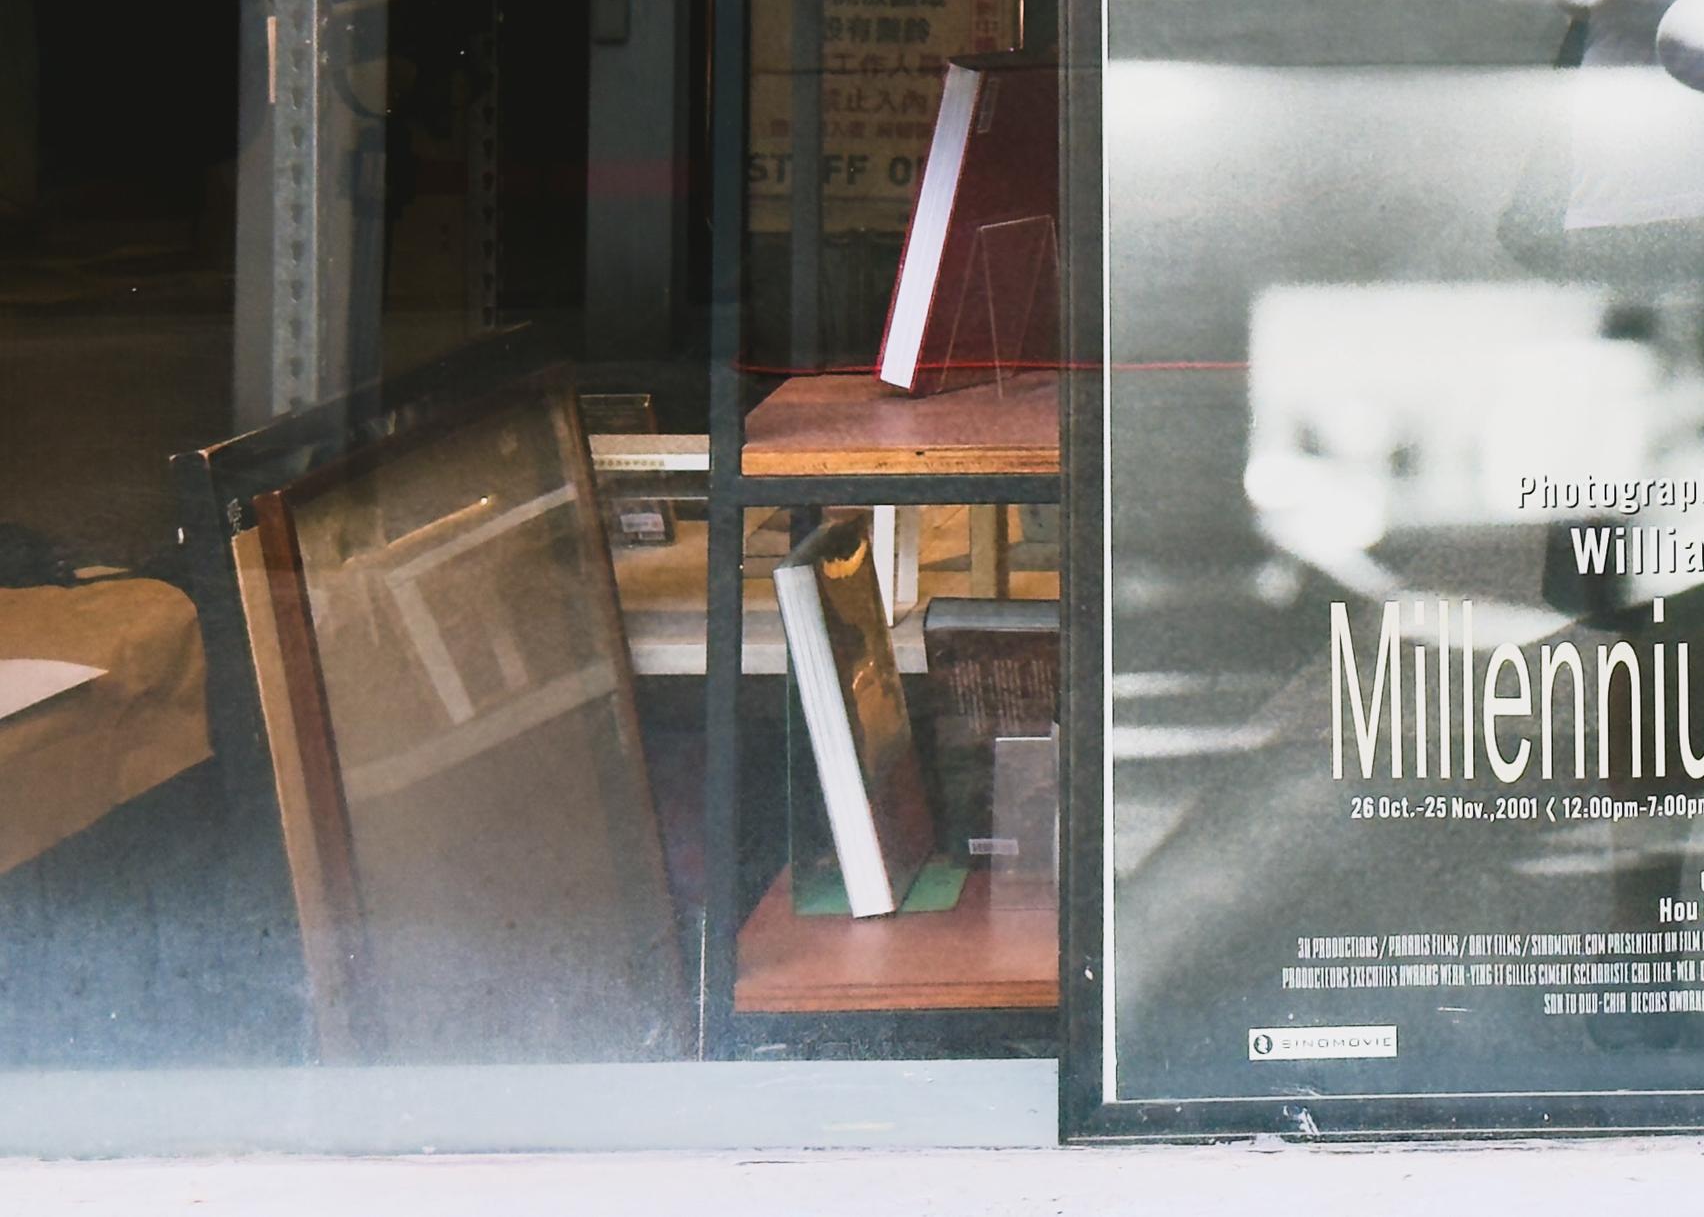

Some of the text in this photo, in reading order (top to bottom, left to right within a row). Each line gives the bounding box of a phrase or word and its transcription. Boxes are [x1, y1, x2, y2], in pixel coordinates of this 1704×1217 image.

[750, 152, 870, 185] STFF
[1350, 796, 1375, 819] 26
[1659, 897, 1698, 923] Hou
[1312, 936, 1378, 959] PRODUCTIONS
[1432, 934, 1459, 956] FILMS
[1494, 935, 1521, 956] FILMS
[1608, 932, 1662, 955] PRESENTENT
[1679, 931, 1700, 952] FILM
[1282, 966, 1349, 989] PRODUCTEURS
[1506, 963, 1537, 985] GILLES
